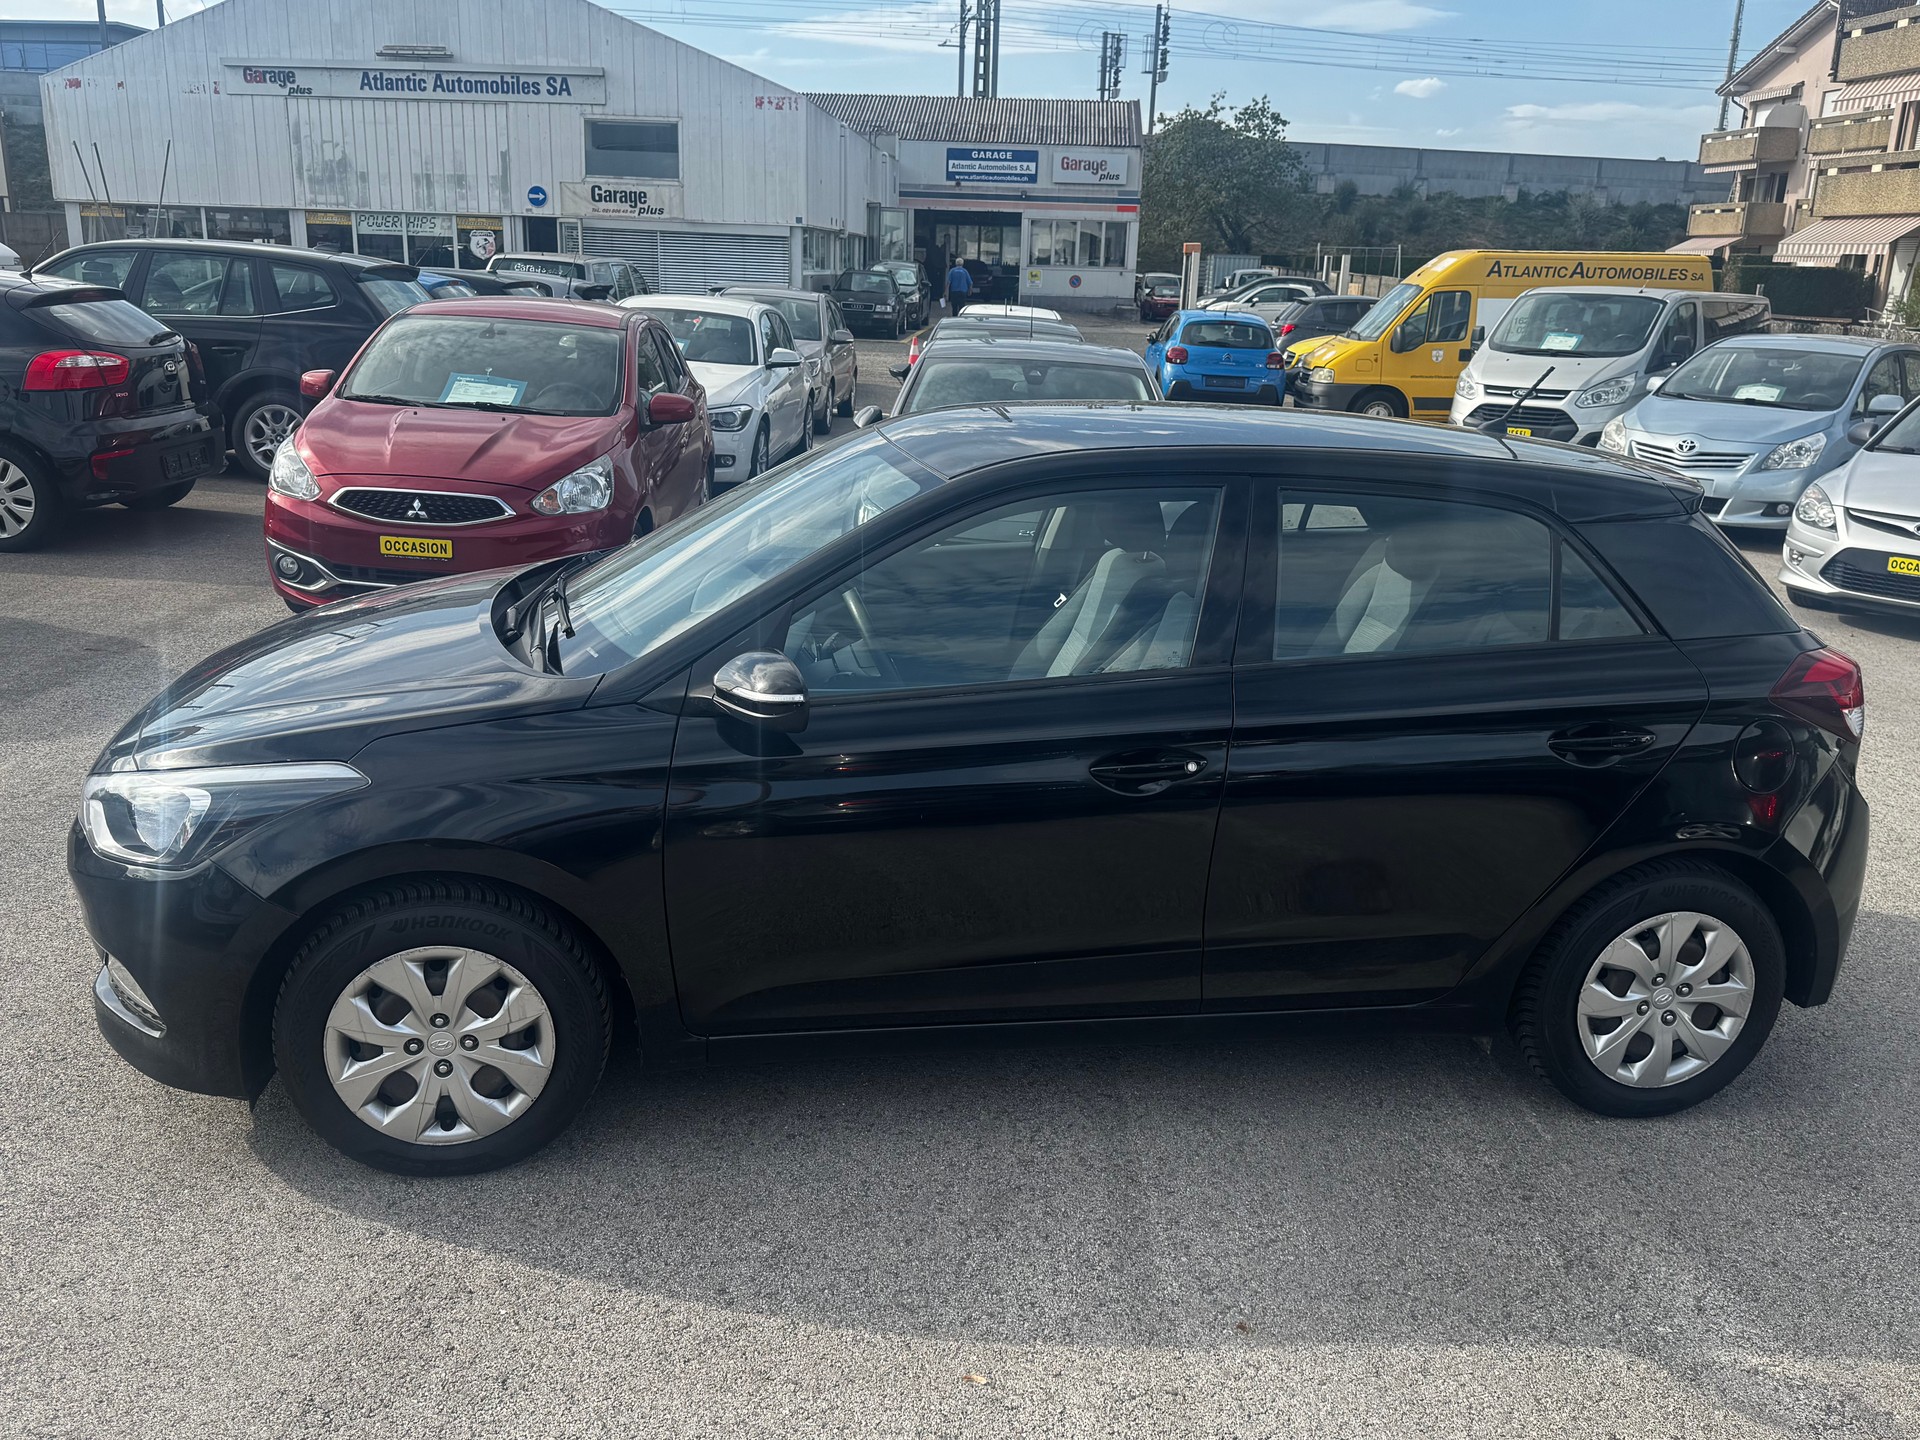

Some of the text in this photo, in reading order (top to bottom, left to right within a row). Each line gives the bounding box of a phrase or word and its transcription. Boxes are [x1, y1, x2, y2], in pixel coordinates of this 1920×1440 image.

[243, 66, 297, 88] Garage
[360, 71, 572, 96] Atlantic Automobiles SA
[288, 85, 313, 96] plus
[971, 150, 1013, 160] GARAGE
[951, 162, 1033, 172] Atlantic Automobiles S.A.
[1061, 156, 1108, 175] Garage
[955, 174, 1029, 182] www.atlanticautomobiles.ch
[1099, 172, 1120, 182] plus
[590, 184, 648, 209] Garage
[637, 205, 665, 216] plus
[1486, 260, 1705, 282] ATLANTIC AUTOMOBILES SA
[384, 540, 448, 555] OCCASION
